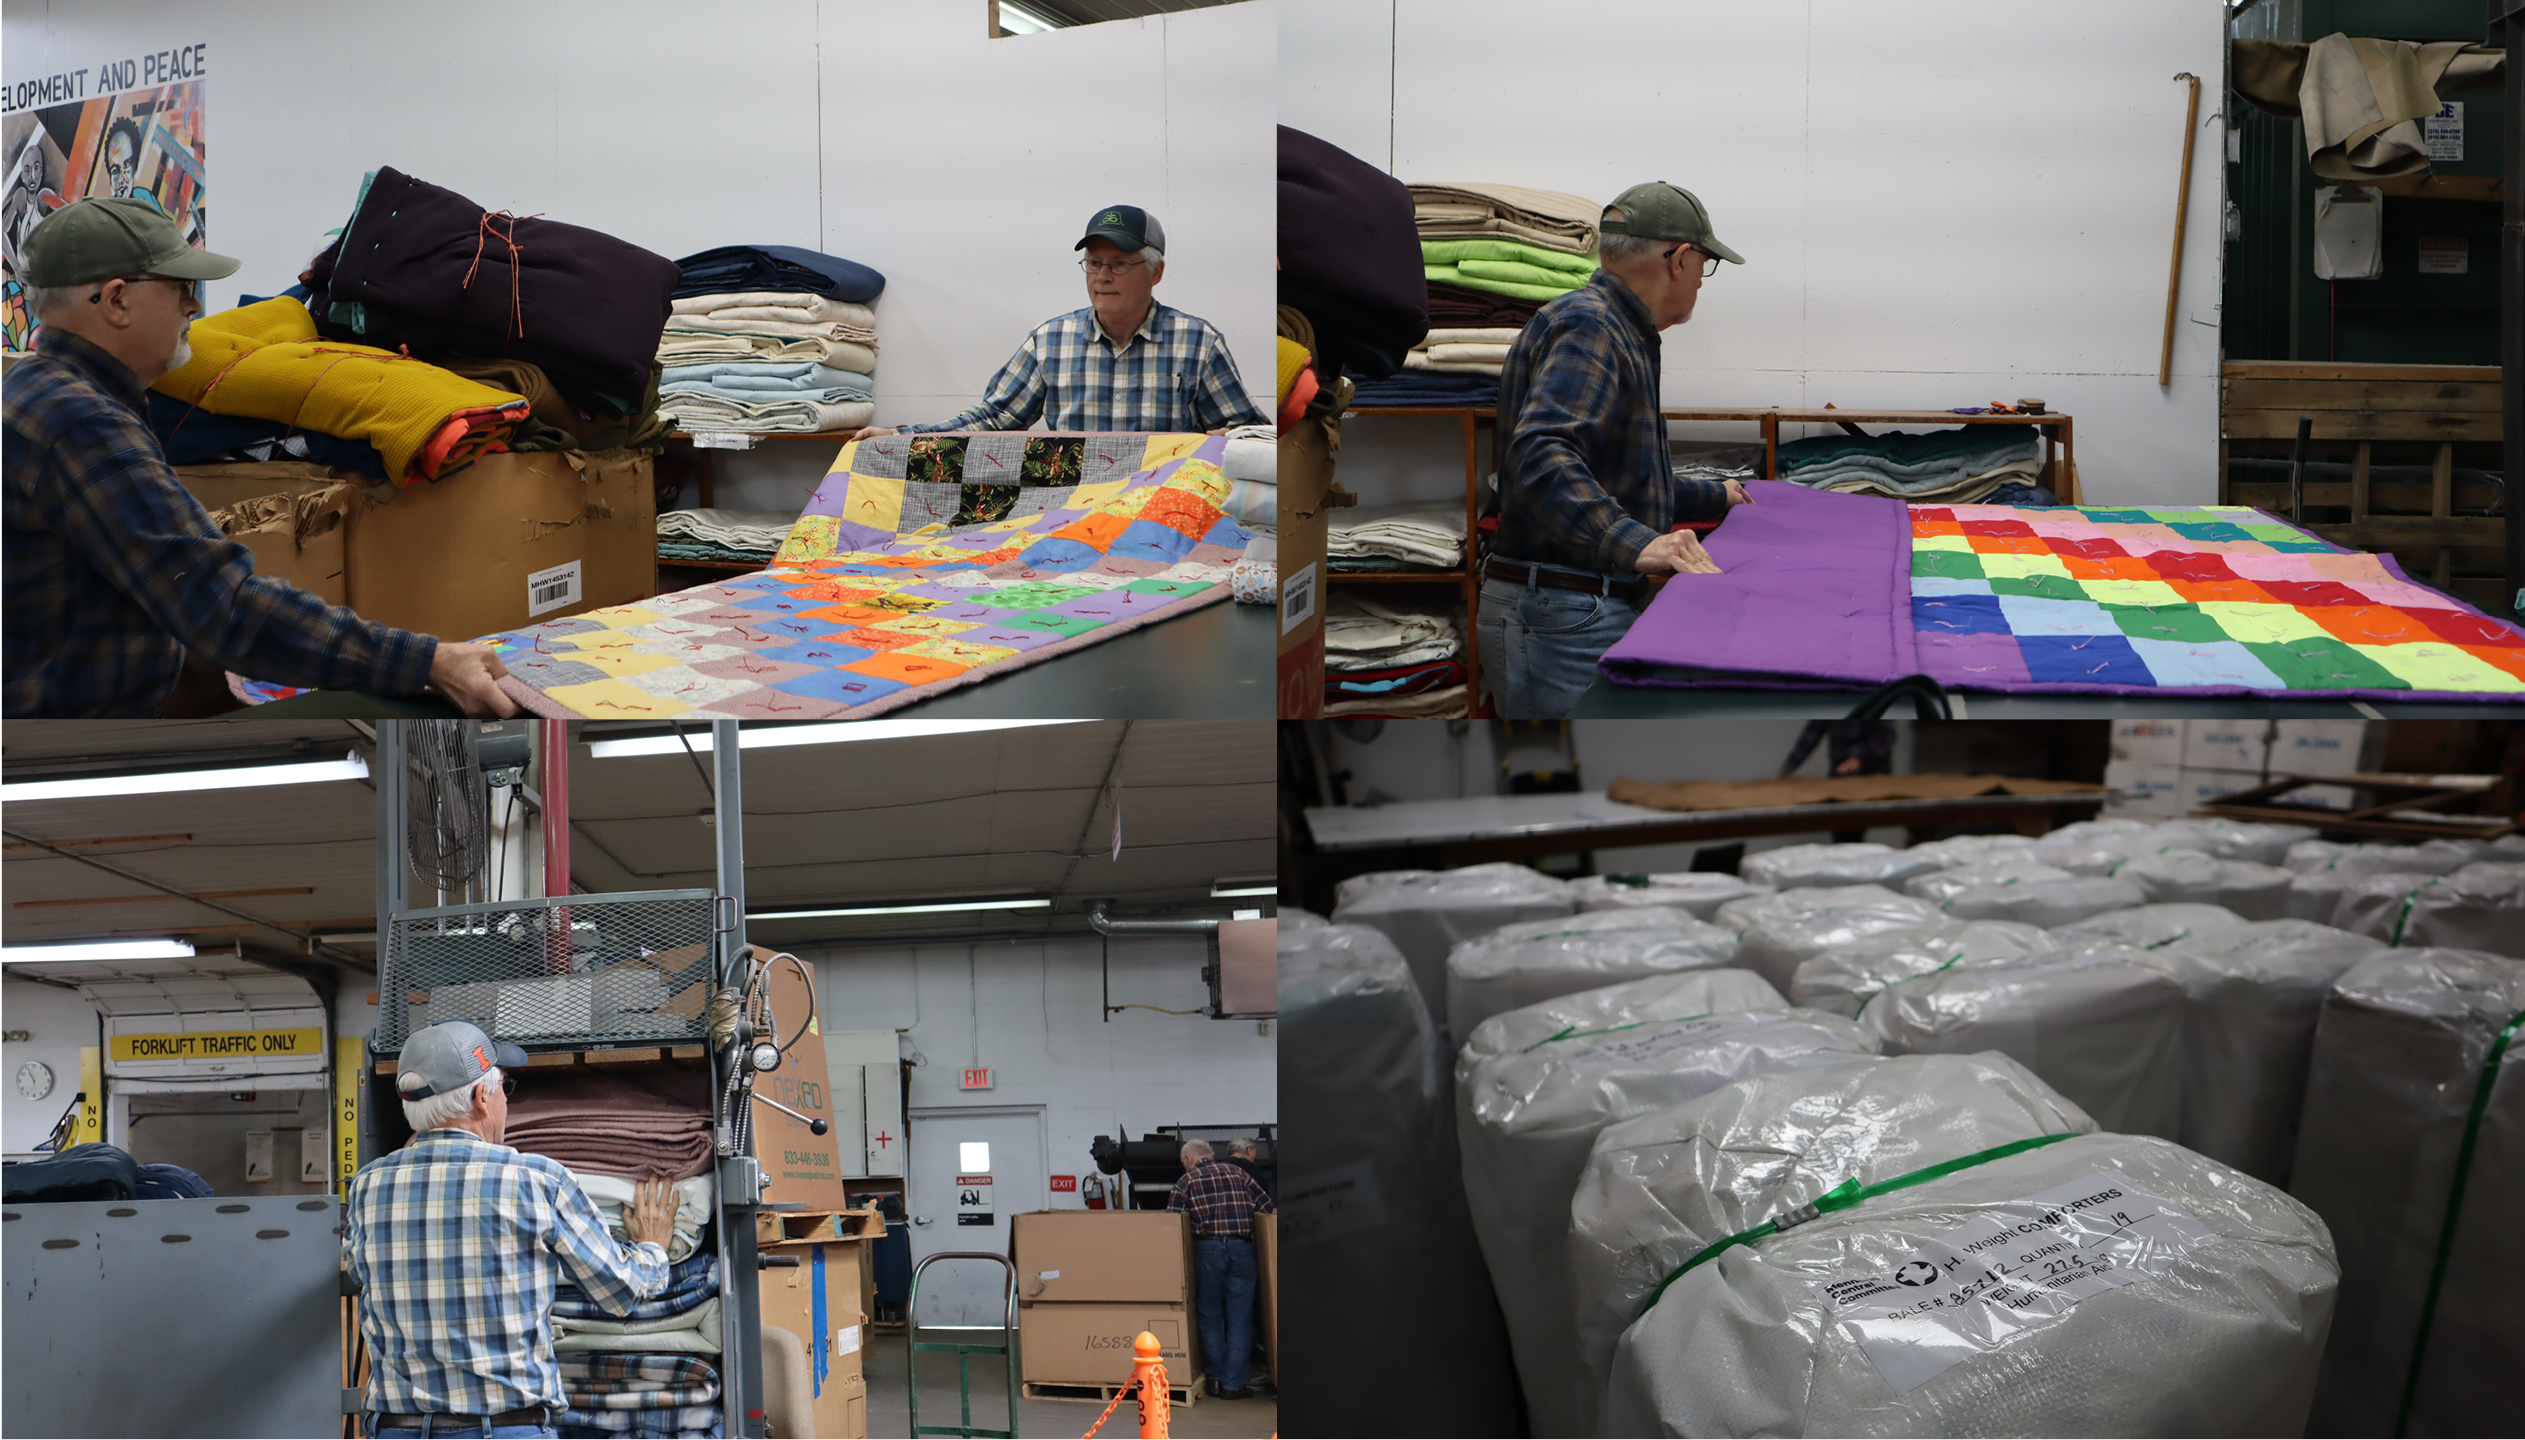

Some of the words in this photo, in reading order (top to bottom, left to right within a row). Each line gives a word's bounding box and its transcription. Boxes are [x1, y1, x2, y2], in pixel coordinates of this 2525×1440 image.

[98, 58, 136, 94] AND
[144, 43, 206, 86] PEACE
[2422, 240, 2465, 250] WARNING
[531, 571, 574, 589] MHW1453142
[132, 1038, 196, 1056] FORKLIFT
[201, 1035, 257, 1054] TRAFFIC
[262, 1033, 297, 1052] ONLY
[965, 1069, 989, 1087] EXIT
[773, 1076, 823, 1110] nexeo
[88, 1105, 96, 1128] NO
[344, 1098, 354, 1121] NO
[1052, 1180, 1074, 1188] EXIT
[1962, 1229, 2020, 1255] Weight
[2017, 1188, 2123, 1234] COMFORTERS
[1887, 1300, 1933, 1323] BALE
[1932, 1297, 1944, 1308] #
[2110, 1211, 2134, 1227] 19
[1831, 1281, 1876, 1299] Central
[2007, 1271, 2092, 1310] Humanitarian
[1085, 1335, 1133, 1351] 16588
